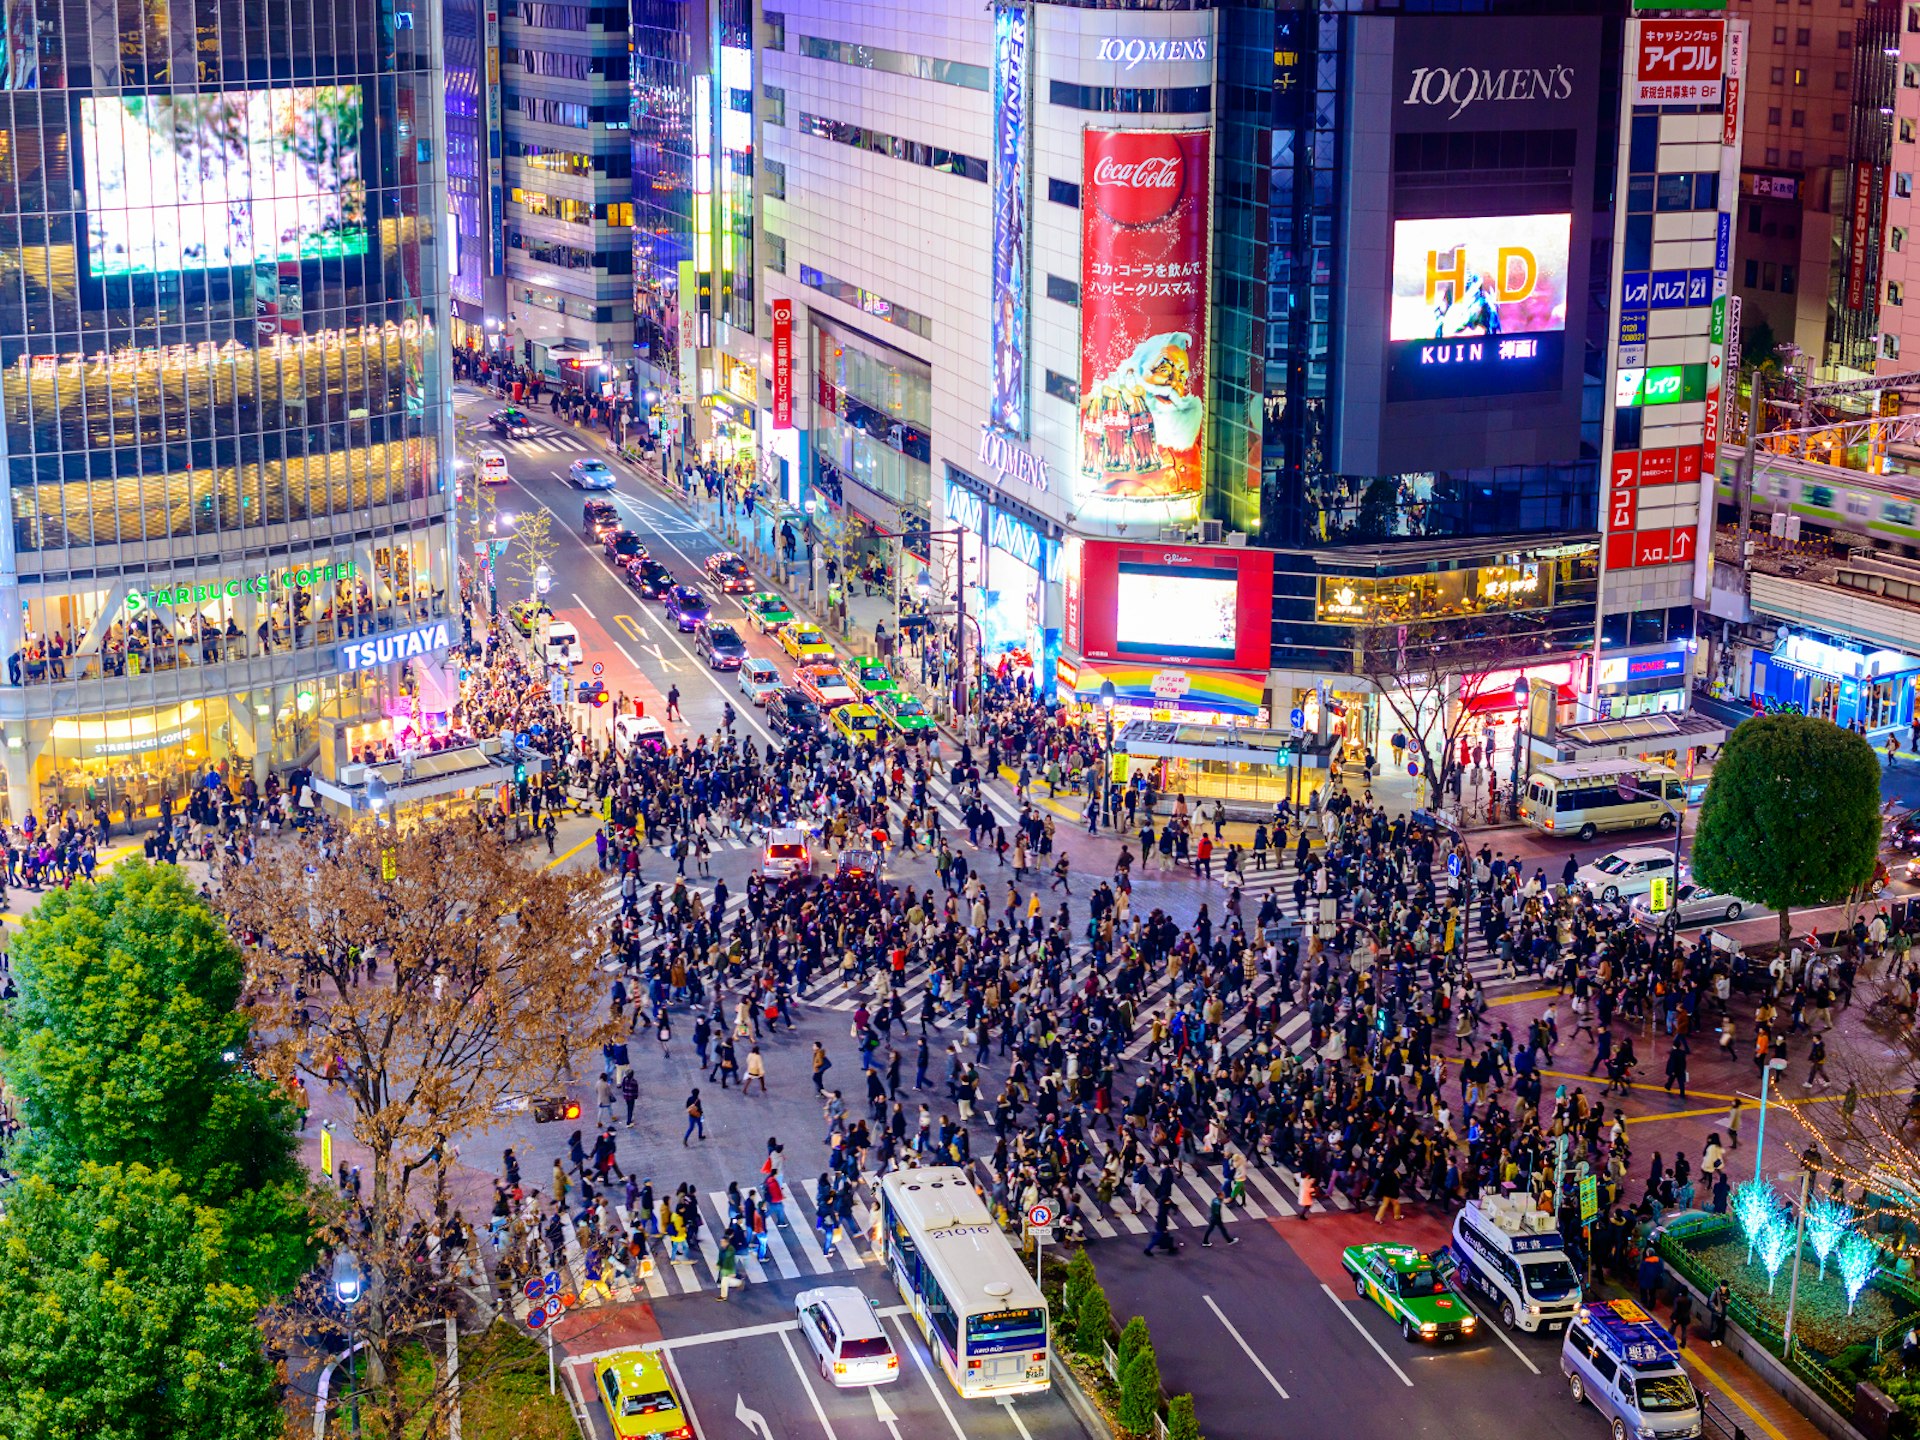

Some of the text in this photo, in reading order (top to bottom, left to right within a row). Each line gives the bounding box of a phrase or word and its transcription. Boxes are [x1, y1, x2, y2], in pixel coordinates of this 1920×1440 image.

[1645, 30, 1718, 42] キャッシングなら
[1644, 46, 1718, 72] アイフル
[1004, 19, 1026, 155] WINTER
[1640, 85, 1717, 99] 新規会員募集中 8F
[1727, 91, 1737, 139] アイフル
[1093, 155, 1182, 189] Coca-Cola
[1496, 246, 1537, 303] D
[1625, 277, 1707, 302] レオパレス21
[1714, 305, 1723, 336] レイク
[1422, 343, 1484, 364] KUIN
[1626, 356, 1637, 365] 6F
[777, 337, 788, 421] 三菱東京UFJ銀行
[1645, 376, 1681, 395] レイク
[1705, 399, 1718, 442] アコム
[1613, 468, 1633, 527] アコム
[1162, 553, 1193, 565] Glico
[1641, 547, 1663, 563] 入口
[126, 561, 359, 611] STARBUCKS COFFEE
[343, 624, 450, 670] TSUTAYA
[1630, 660, 1667, 674] PROMISE
[95, 738, 158, 754] STARBUCKS
[933, 1225, 990, 1240] 21016
